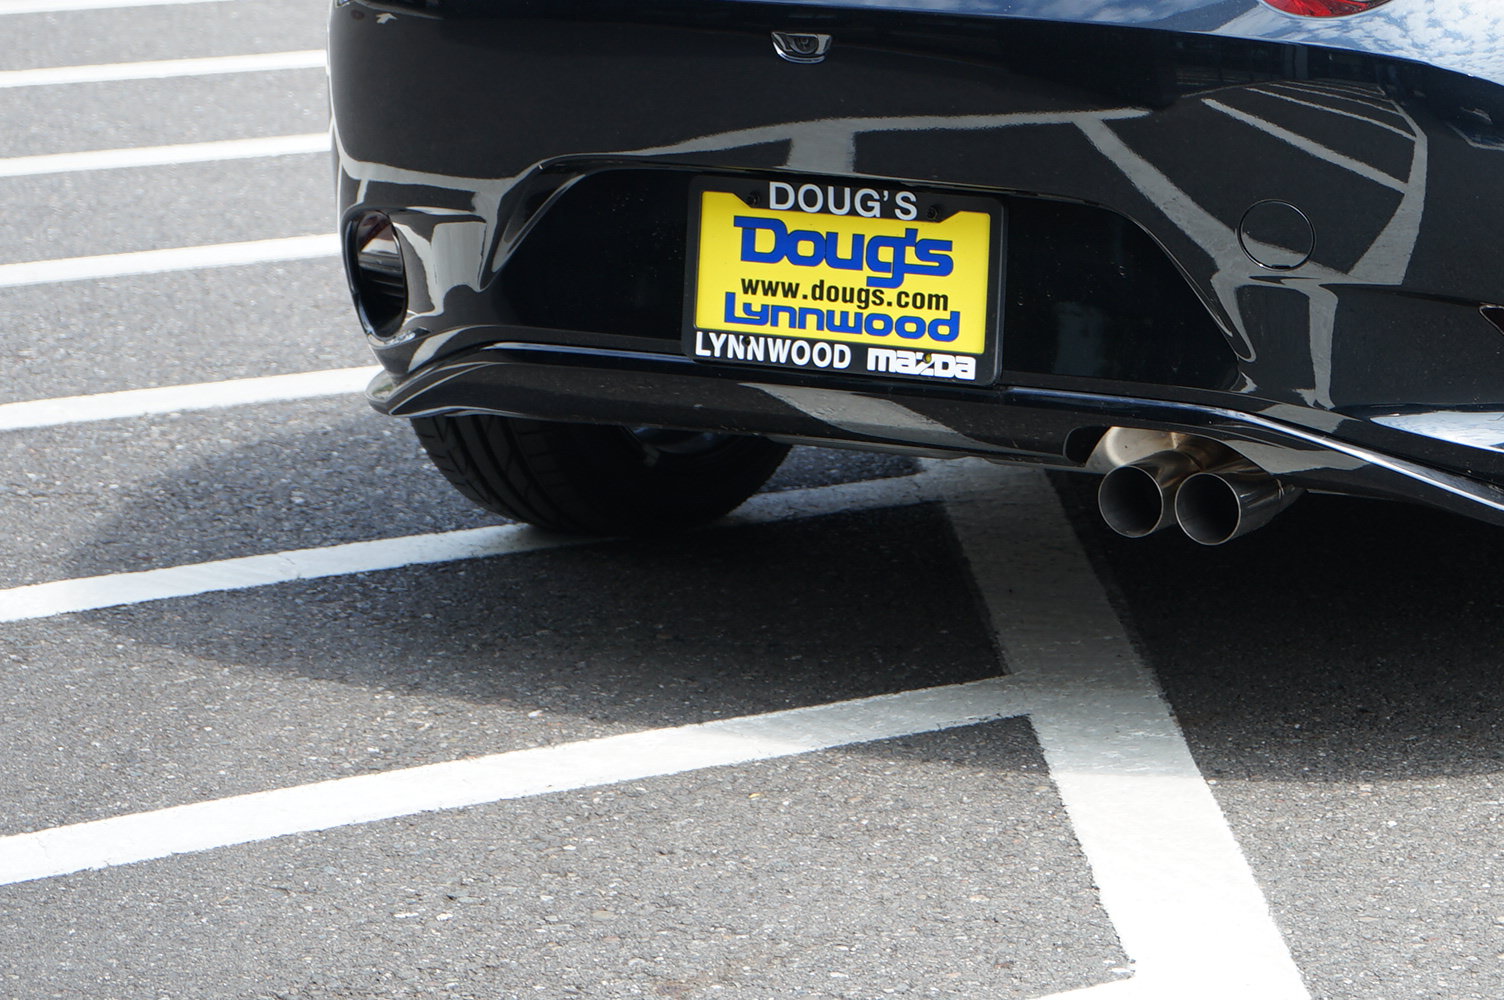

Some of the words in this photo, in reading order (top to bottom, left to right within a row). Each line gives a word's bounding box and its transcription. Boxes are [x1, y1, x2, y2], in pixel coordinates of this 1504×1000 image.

[769, 181, 918, 221] DOUG'S
[733, 215, 954, 289] Doug's
[741, 278, 949, 311] www.dougs.com
[724, 291, 961, 342] Lynnwood
[695, 331, 851, 369] LYNNWOOD
